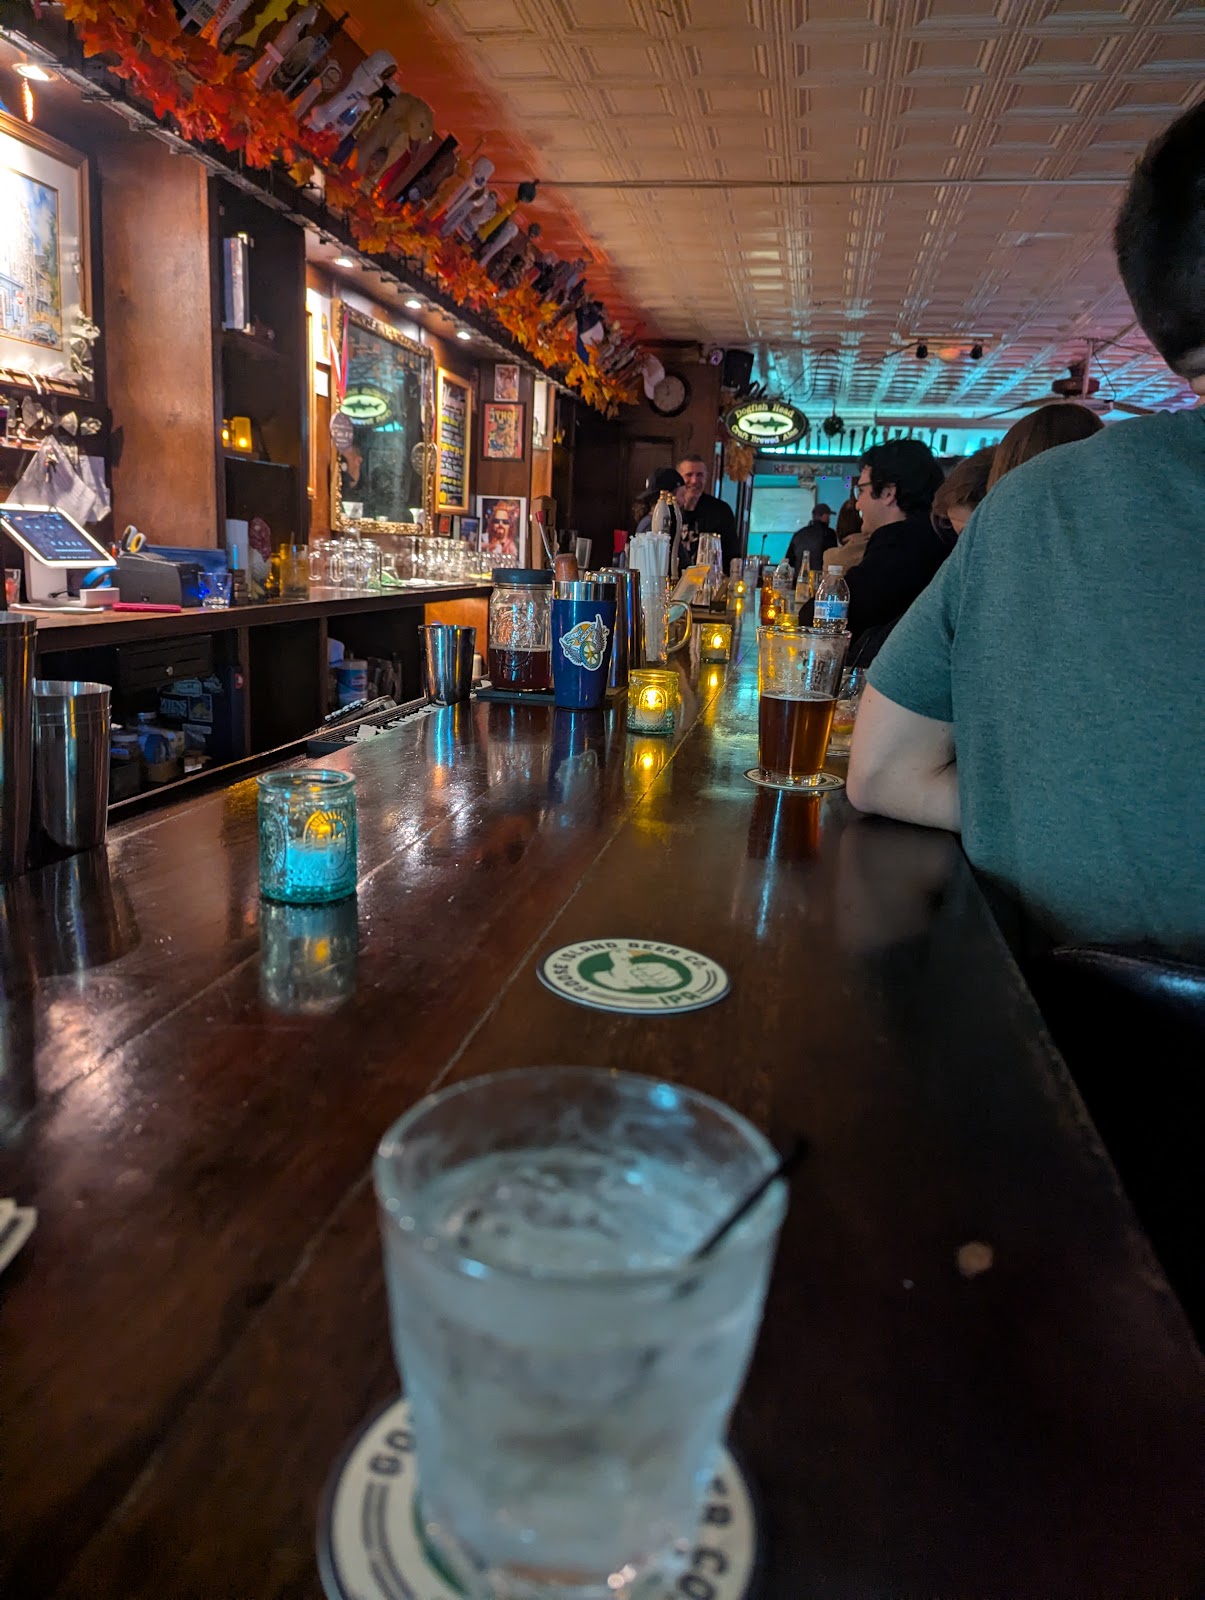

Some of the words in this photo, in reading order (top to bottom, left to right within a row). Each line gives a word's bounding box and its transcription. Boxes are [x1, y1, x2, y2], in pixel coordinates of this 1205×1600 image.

[734, 402, 769, 419] Dogfish
[772, 403, 795, 418] Head
[731, 424, 749, 441] Craft
[750, 435, 780, 445] Brewed
[558, 942, 617, 961] ISLAND
[628, 942, 679, 956] BEER
[553, 963, 589, 992] GOOSE
[658, 991, 702, 1006] IPA
